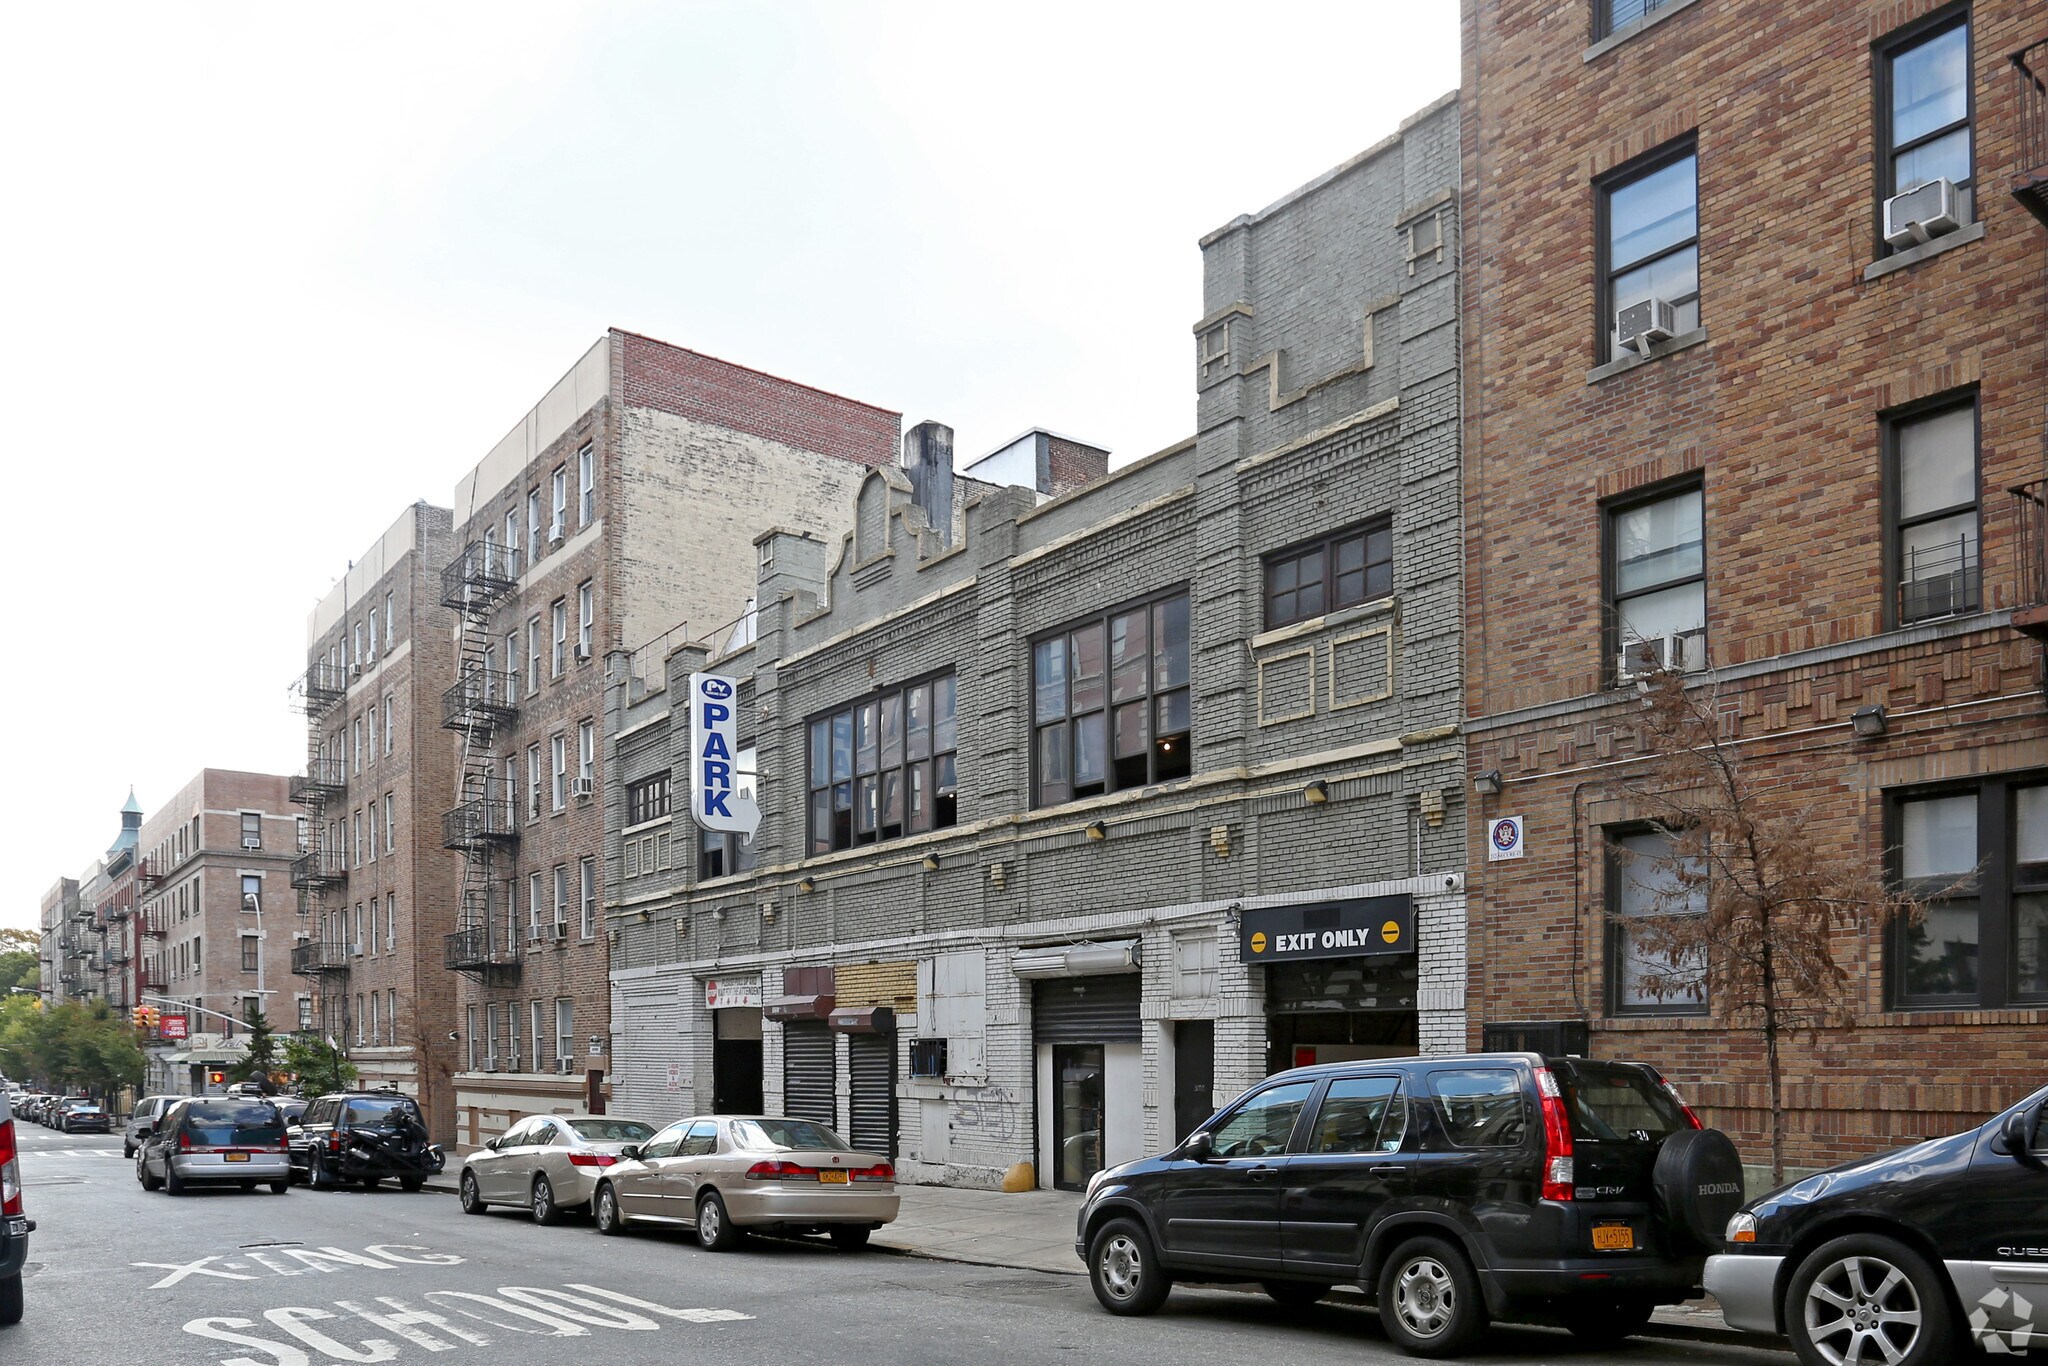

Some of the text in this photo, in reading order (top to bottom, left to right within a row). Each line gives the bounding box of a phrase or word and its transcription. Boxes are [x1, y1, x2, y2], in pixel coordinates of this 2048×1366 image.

[702, 702, 733, 818] PARK
[1275, 927, 1370, 952] EXIT ONLY
[1698, 1182, 1741, 1196] HONDA
[182, 1283, 757, 1366] SCHOOL
